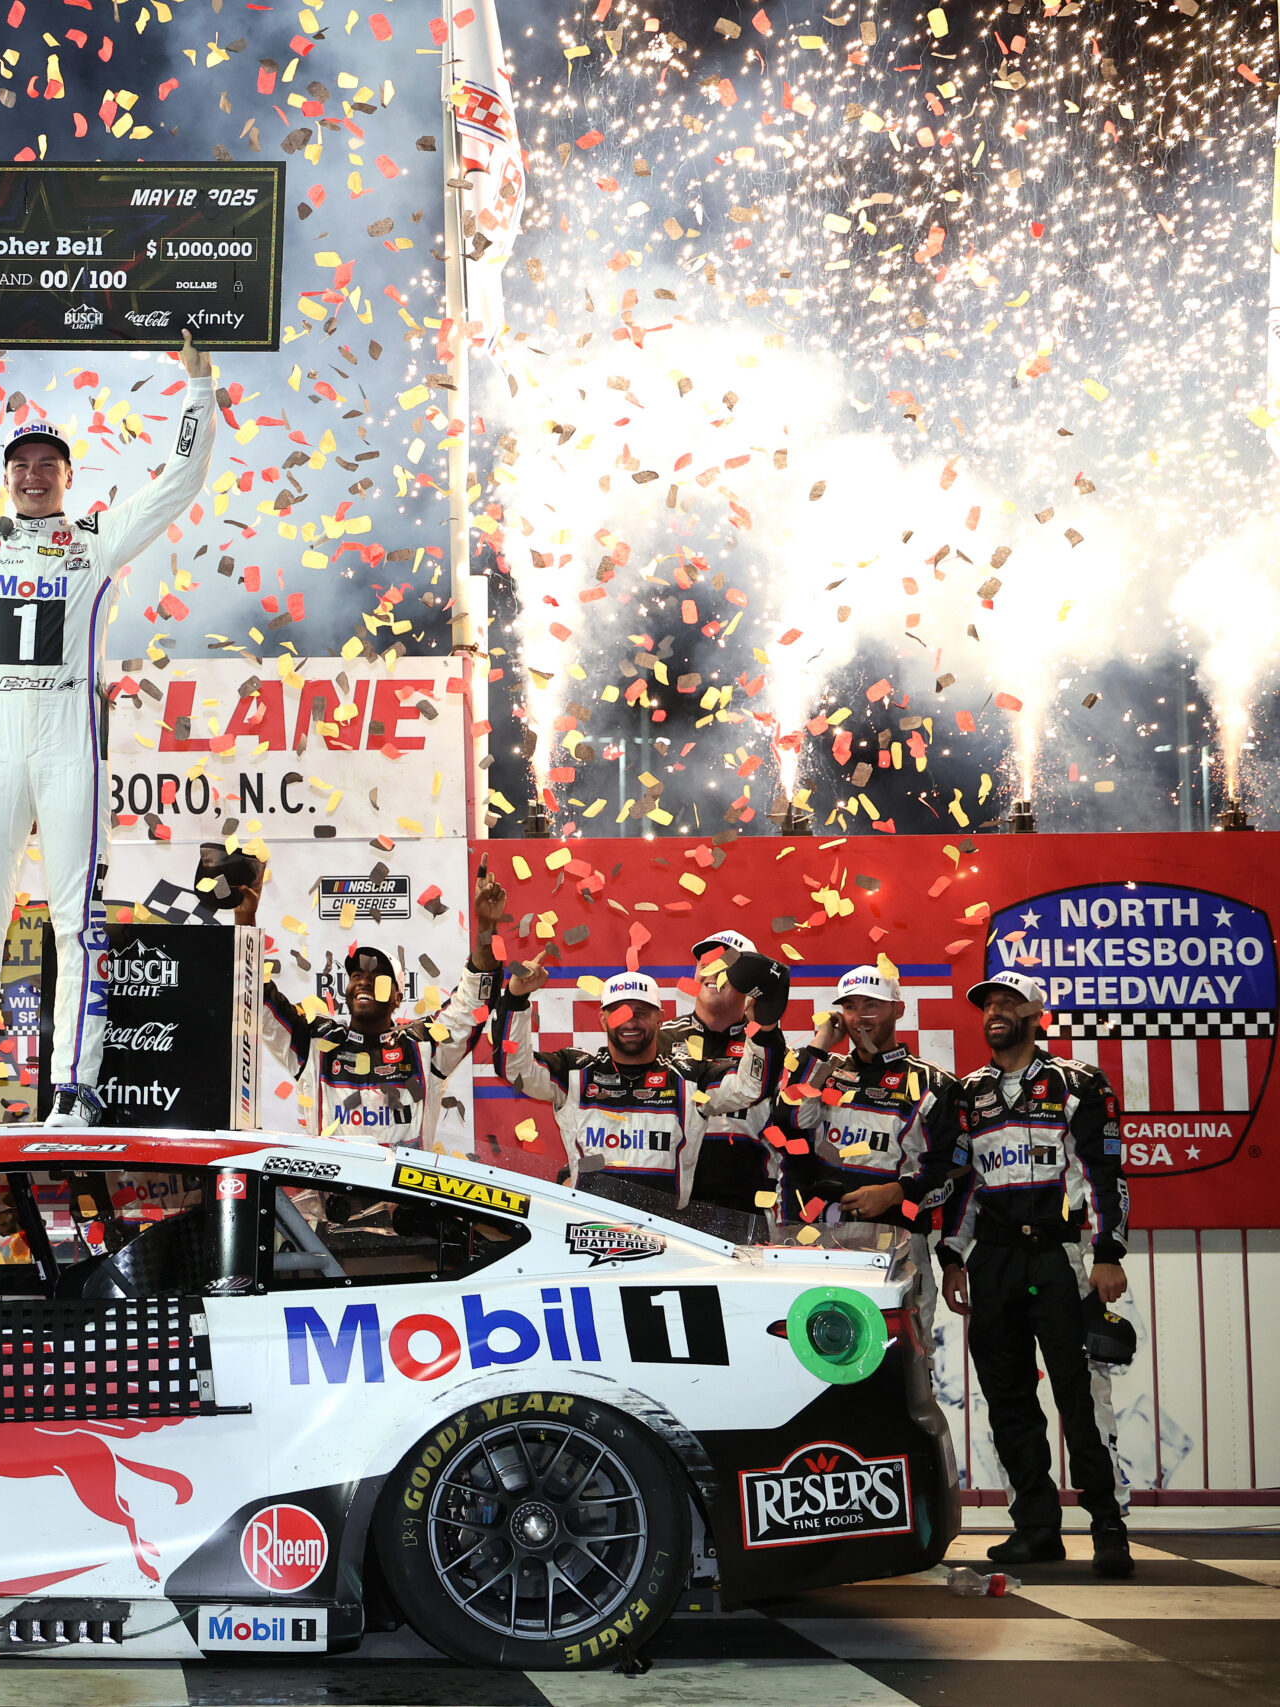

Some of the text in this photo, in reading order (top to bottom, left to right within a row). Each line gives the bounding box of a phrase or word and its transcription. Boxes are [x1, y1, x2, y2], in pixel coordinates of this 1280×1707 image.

[130, 189, 176, 206] MAY
[176, 189, 198, 206] 18
[56, 236, 102, 256] Bell
[146, 240, 253, 259] $ 1,000,000
[176, 281, 218, 290] DOLLARS
[64, 312, 104, 326] BUSCH
[124, 310, 173, 327] Coca-Cola
[186, 309, 245, 329] xfinity
[14, 424, 47, 438] Mobil
[13, 603, 38, 661] 1
[158, 680, 435, 752] LANE
[239, 773, 317, 814] N.C.
[349, 881, 396, 893] NASCAR
[357, 898, 397, 910] SERIES
[1060, 898, 1199, 927] NORTH
[996, 937, 1264, 968] WILKESBORO
[113, 986, 161, 997] LIGHT
[609, 981, 638, 994] Mobil
[842, 975, 869, 988] Mobil
[1033, 975, 1243, 1005] SPEEDWAY
[241, 936, 255, 1085] CUP SERIES
[335, 1105, 390, 1126] Mobil
[585, 1126, 644, 1151] Mobil
[1123, 1122, 1233, 1139] CAROLINA
[978, 1144, 1030, 1174] Mobil
[398, 1165, 526, 1211] DEWALT
[578, 1238, 658, 1251] BATTERIES
[284, 1286, 602, 1386] Mobil
[650, 1290, 690, 1359] 1
[754, 1465, 900, 1537] RESER'S
[793, 1513, 864, 1530] FINE FOODS
[253, 1521, 322, 1578] Rheem
[208, 1617, 310, 1642] Mobil 1
[564, 1598, 651, 1665] EAGLE
